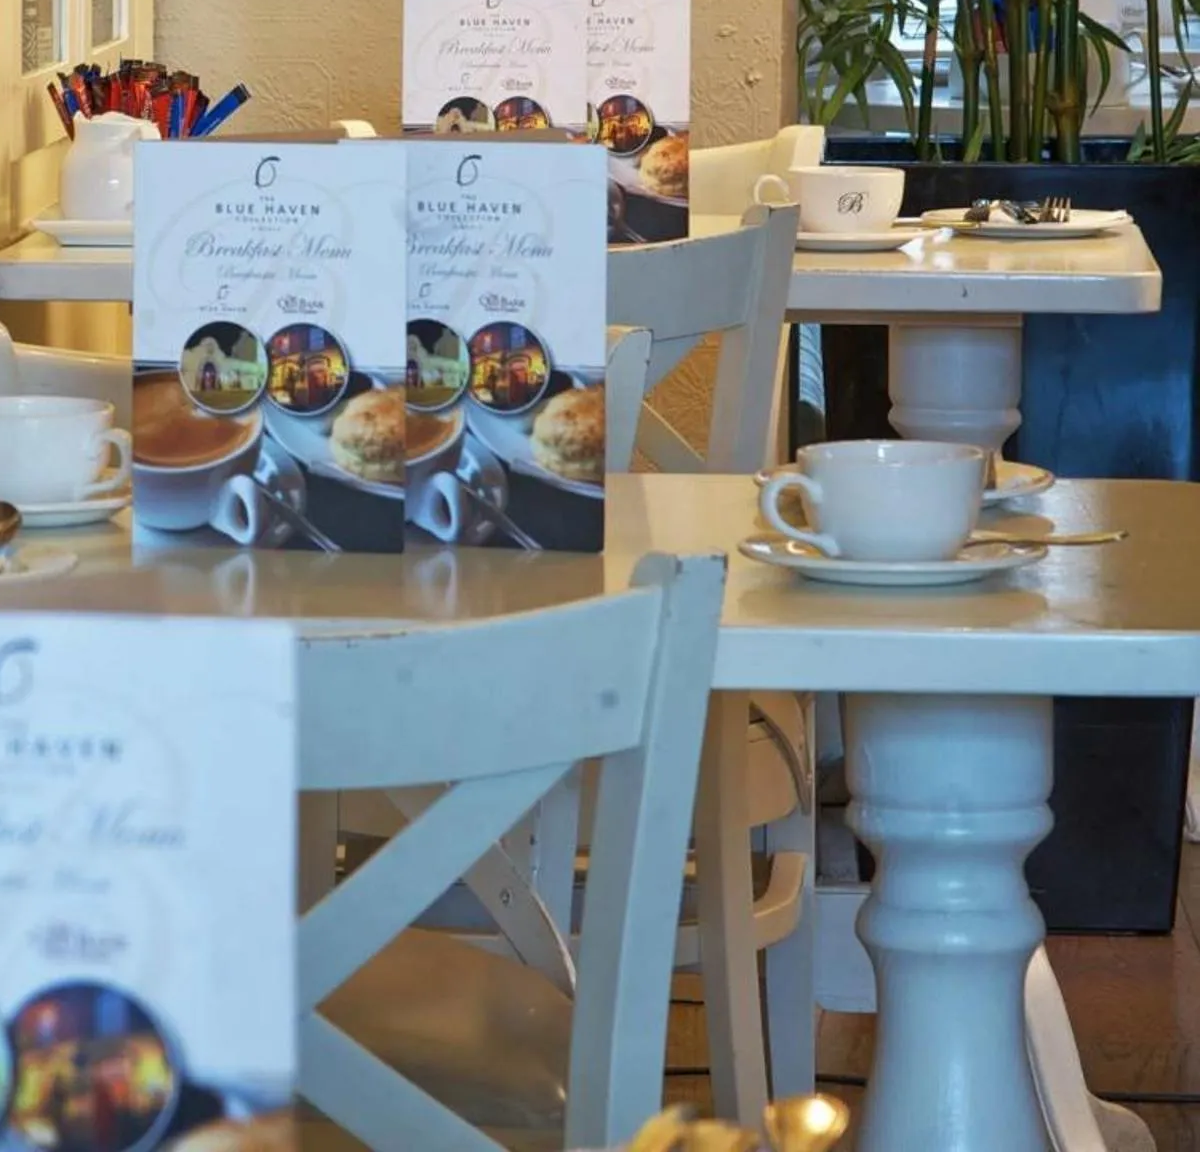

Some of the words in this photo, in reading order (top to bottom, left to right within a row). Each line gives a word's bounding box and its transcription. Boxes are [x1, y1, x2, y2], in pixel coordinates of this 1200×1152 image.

[460, 19, 486, 27] BLUE
[493, 19, 531, 27] HAVEN
[599, 17, 635, 26] HAVEN
[215, 203, 254, 214] BLUE
[265, 204, 320, 215] HAVEN
[417, 201, 456, 213] BLUE
[466, 202, 522, 214] HAVEN
[185, 231, 283, 260] Breakfast
[289, 232, 352, 259] Menu
[497, 232, 554, 258] Menu
